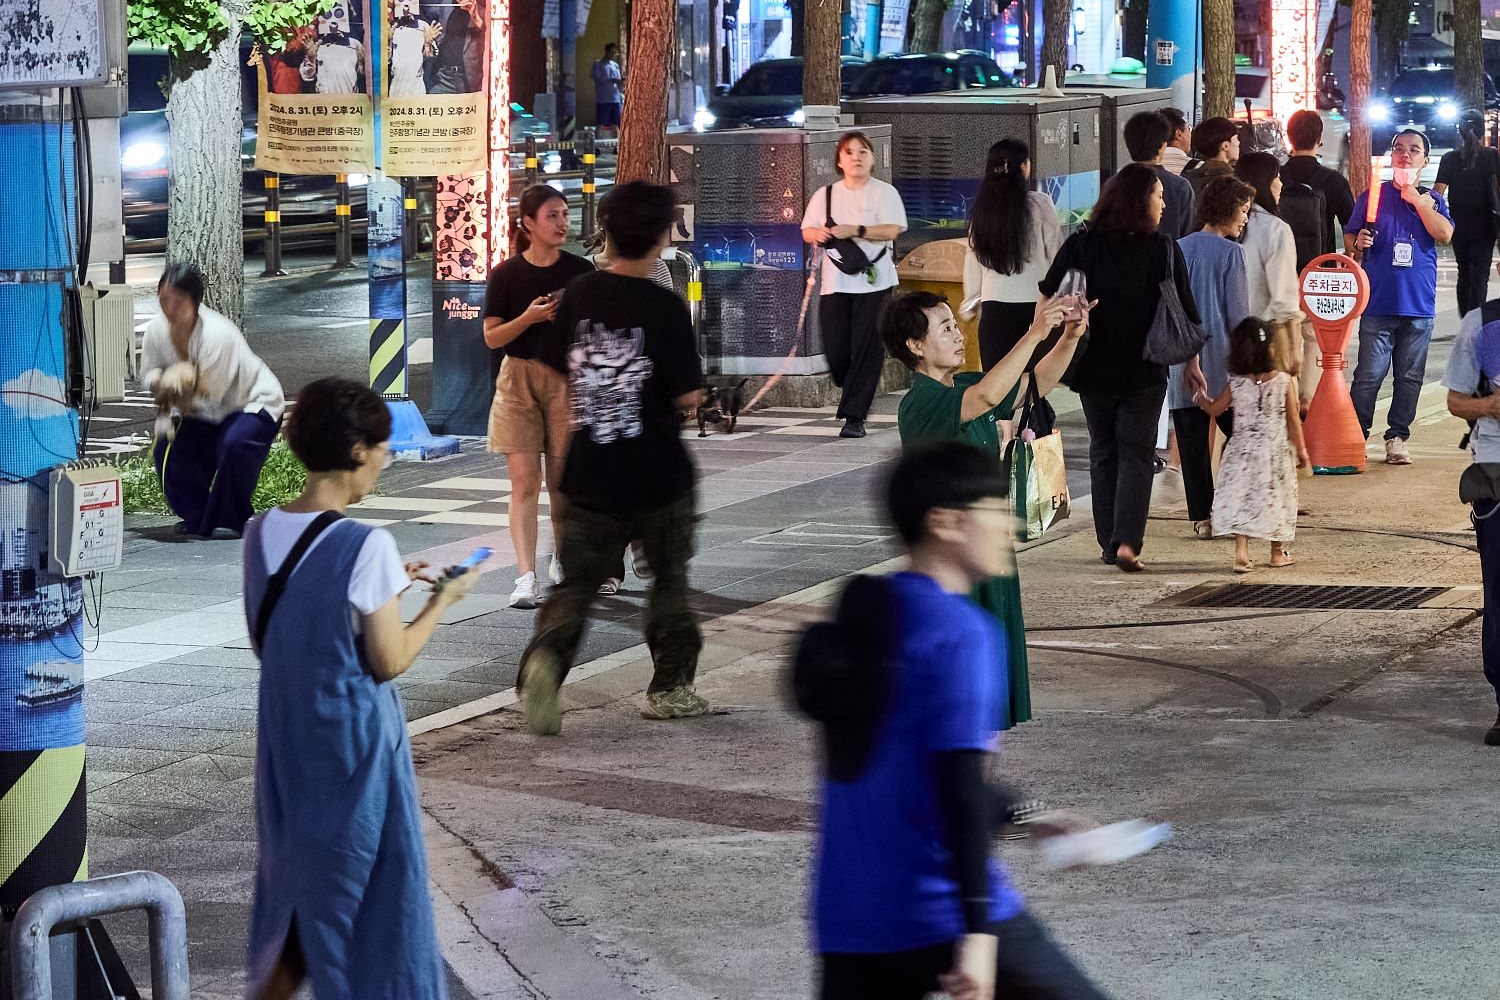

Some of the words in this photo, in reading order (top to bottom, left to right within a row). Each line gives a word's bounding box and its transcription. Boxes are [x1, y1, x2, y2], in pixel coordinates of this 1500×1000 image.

[312, 105, 328, 116] (토)
[331, 106, 348, 116] 오후
[349, 106, 364, 116] 2시
[428, 106, 444, 117] (토)
[447, 106, 464, 116] 오후
[465, 105, 477, 115] 2시
[334, 126, 364, 137] (중극장)
[448, 126, 477, 137] (중극장)
[1308, 279, 1353, 292] 주차금지
